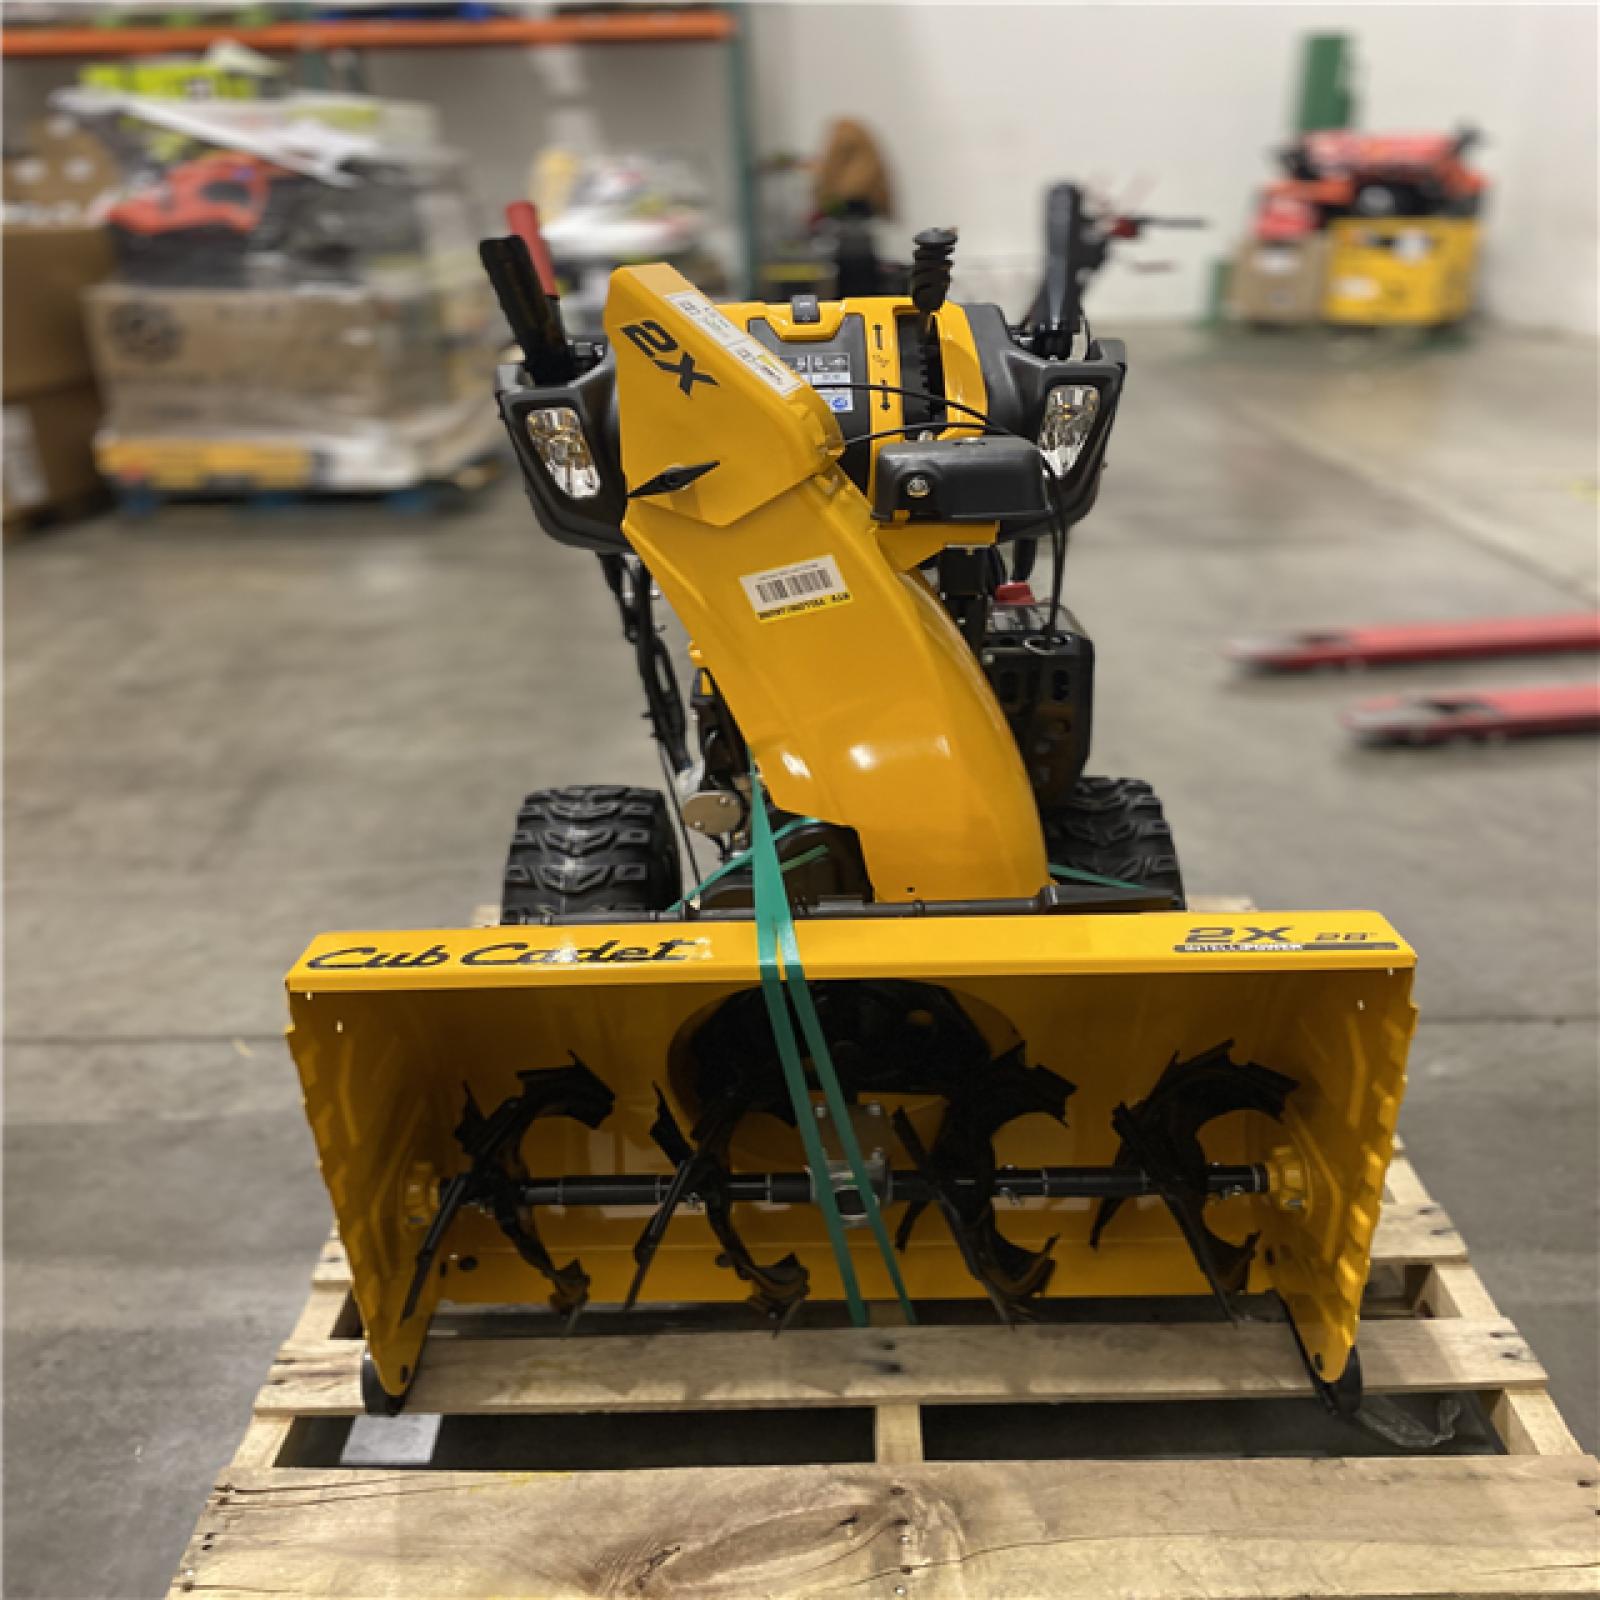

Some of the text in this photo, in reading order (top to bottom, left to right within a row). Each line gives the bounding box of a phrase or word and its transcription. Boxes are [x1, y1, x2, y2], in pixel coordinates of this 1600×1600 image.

[620, 320, 720, 397] 2X
[1185, 927, 1294, 943] 2X
[306, 939, 697, 968] Cub Cadet
